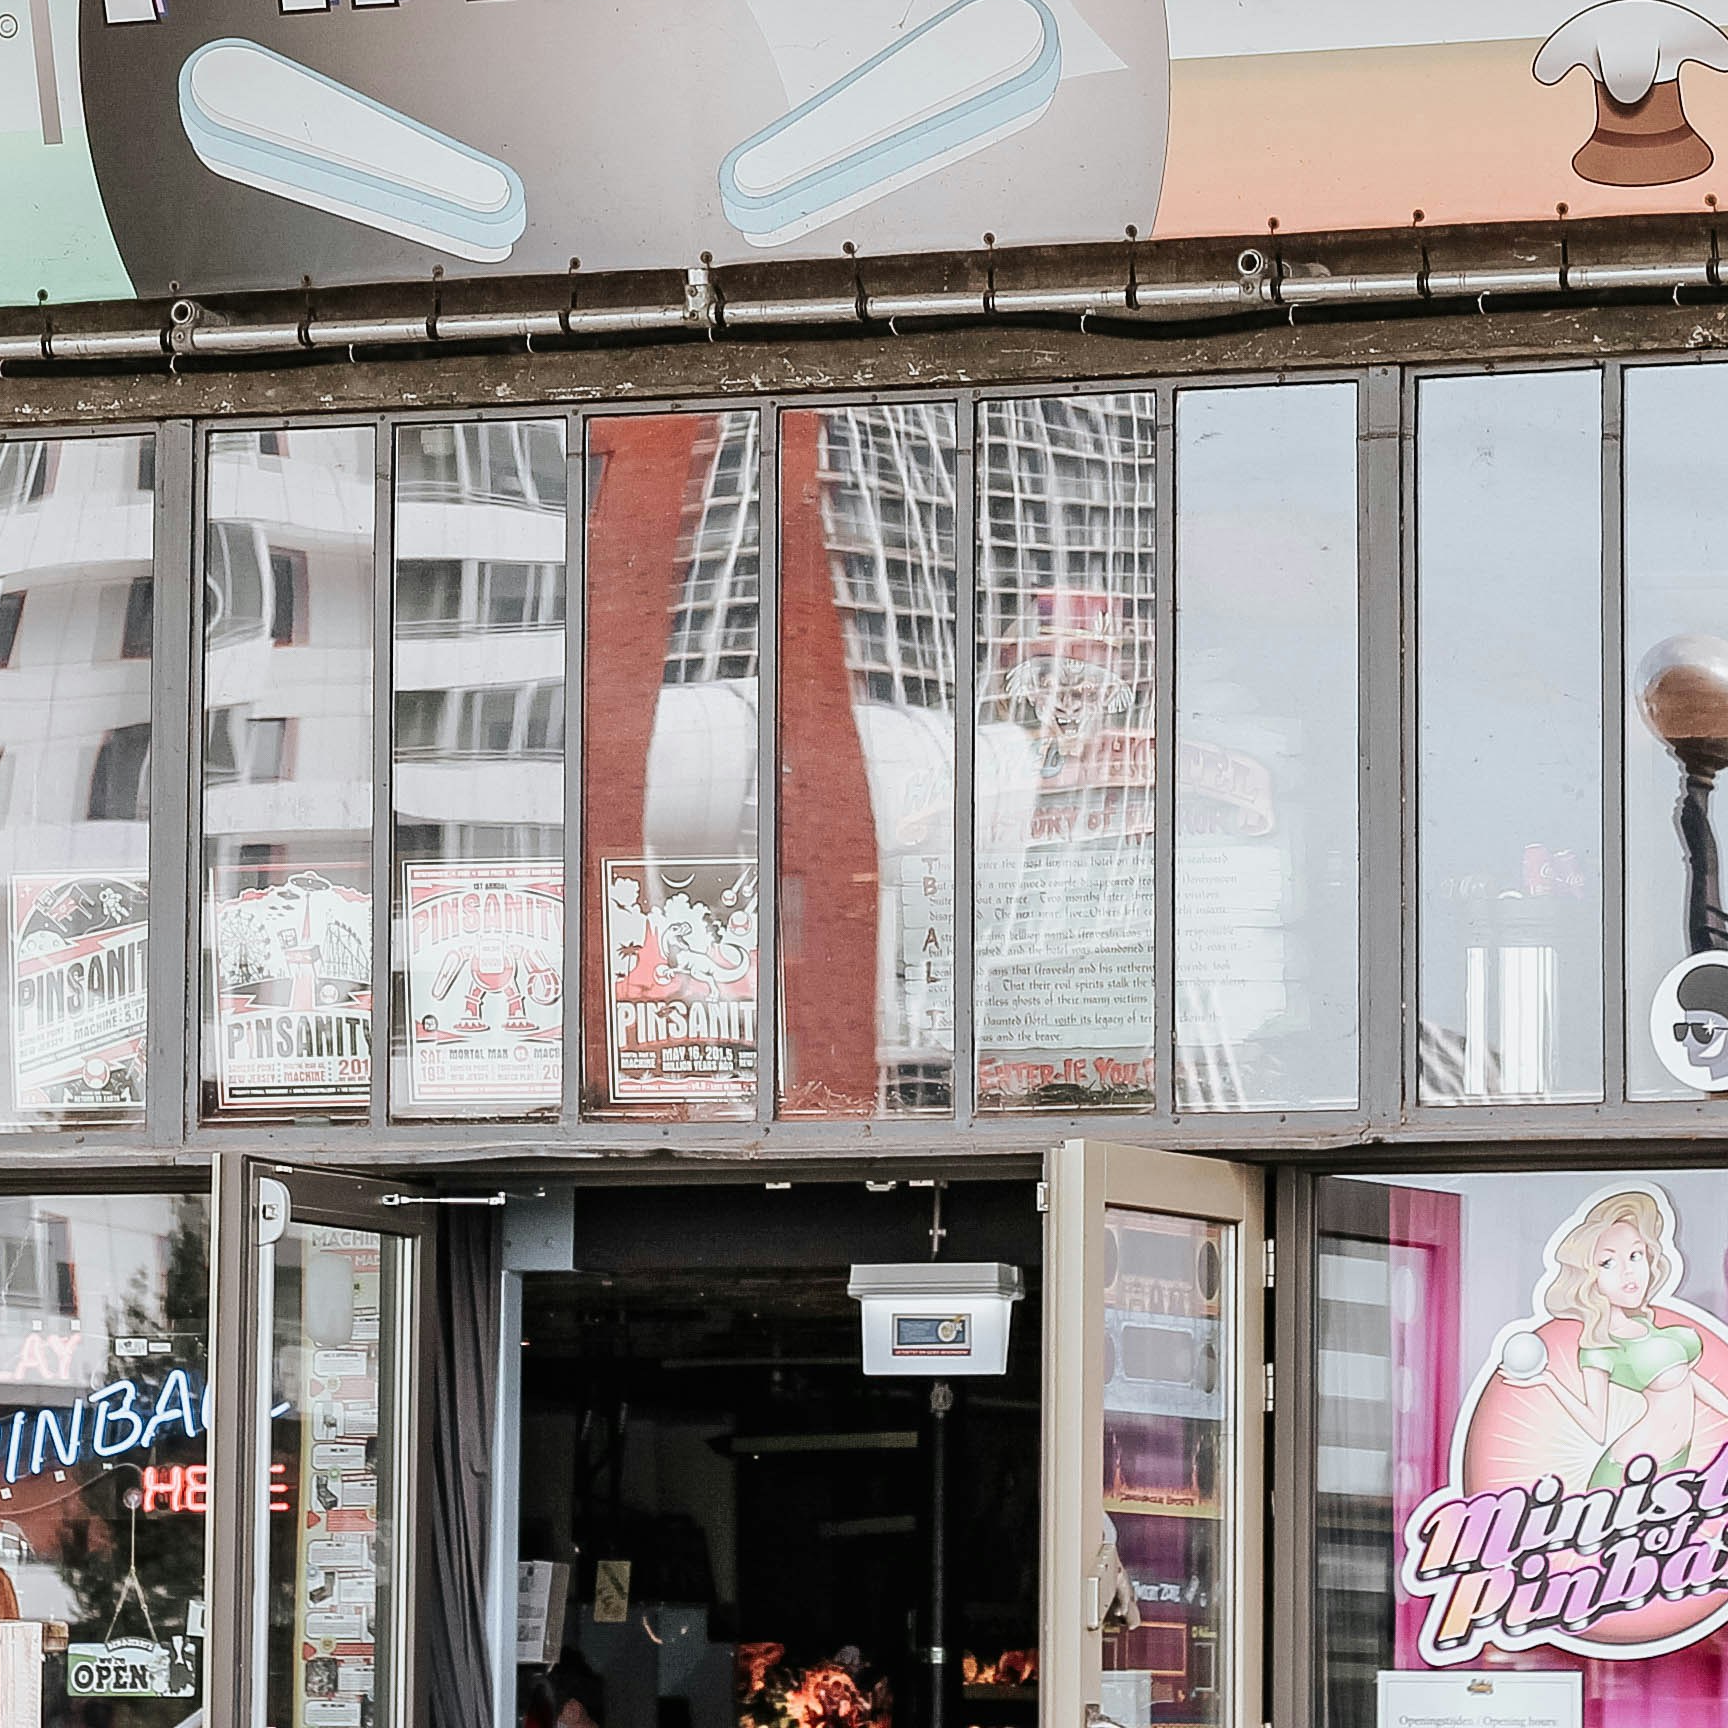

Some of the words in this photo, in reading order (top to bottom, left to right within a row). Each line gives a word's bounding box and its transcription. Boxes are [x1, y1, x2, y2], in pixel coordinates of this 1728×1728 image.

[1078, 962, 1095, 975] and
[1116, 960, 1155, 974] netherw
[16, 939, 149, 1033] PINSANIT
[74, 1016, 119, 1041] MACHINE
[616, 1000, 758, 1049] PINSANIT
[662, 1046, 686, 1061] MAY
[283, 1070, 327, 1083] MACHINE
[337, 1058, 370, 1076] 201
[1643, 1510, 1696, 1556] of
[73, 1663, 150, 1690] OPEN
